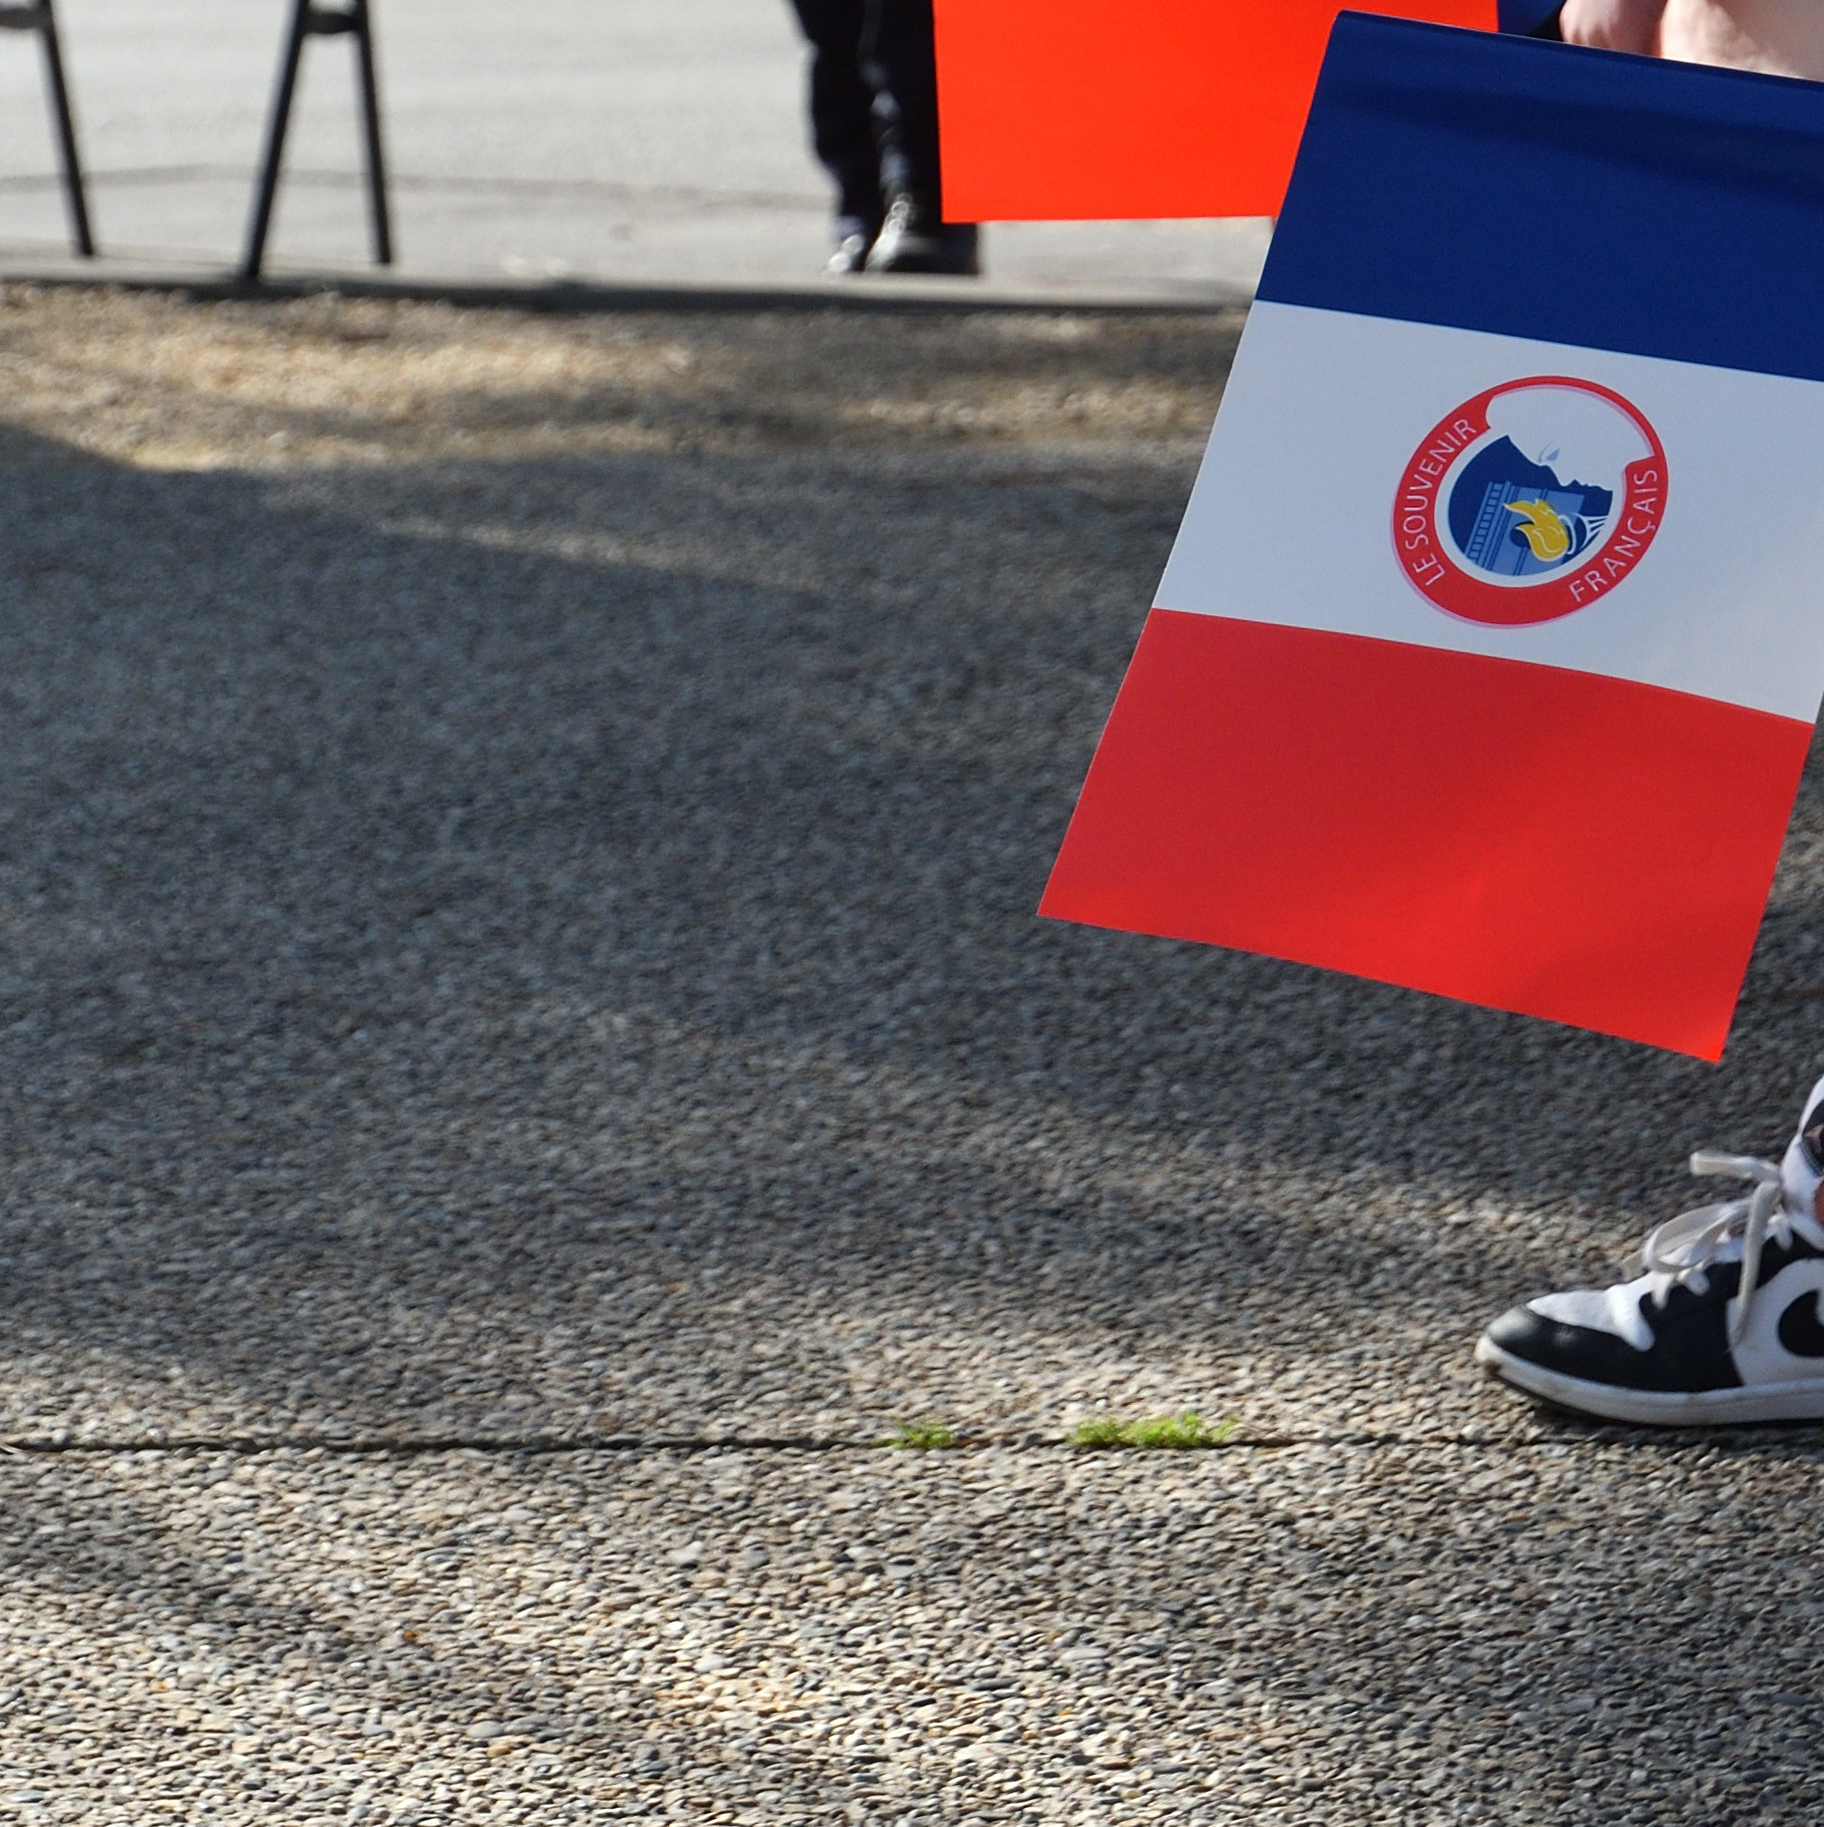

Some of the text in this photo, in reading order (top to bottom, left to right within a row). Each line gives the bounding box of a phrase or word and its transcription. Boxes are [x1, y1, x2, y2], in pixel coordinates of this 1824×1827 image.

[1403, 418, 1477, 586] LE SOUVENIR
[1568, 469, 1658, 603] FRANÇAIS
